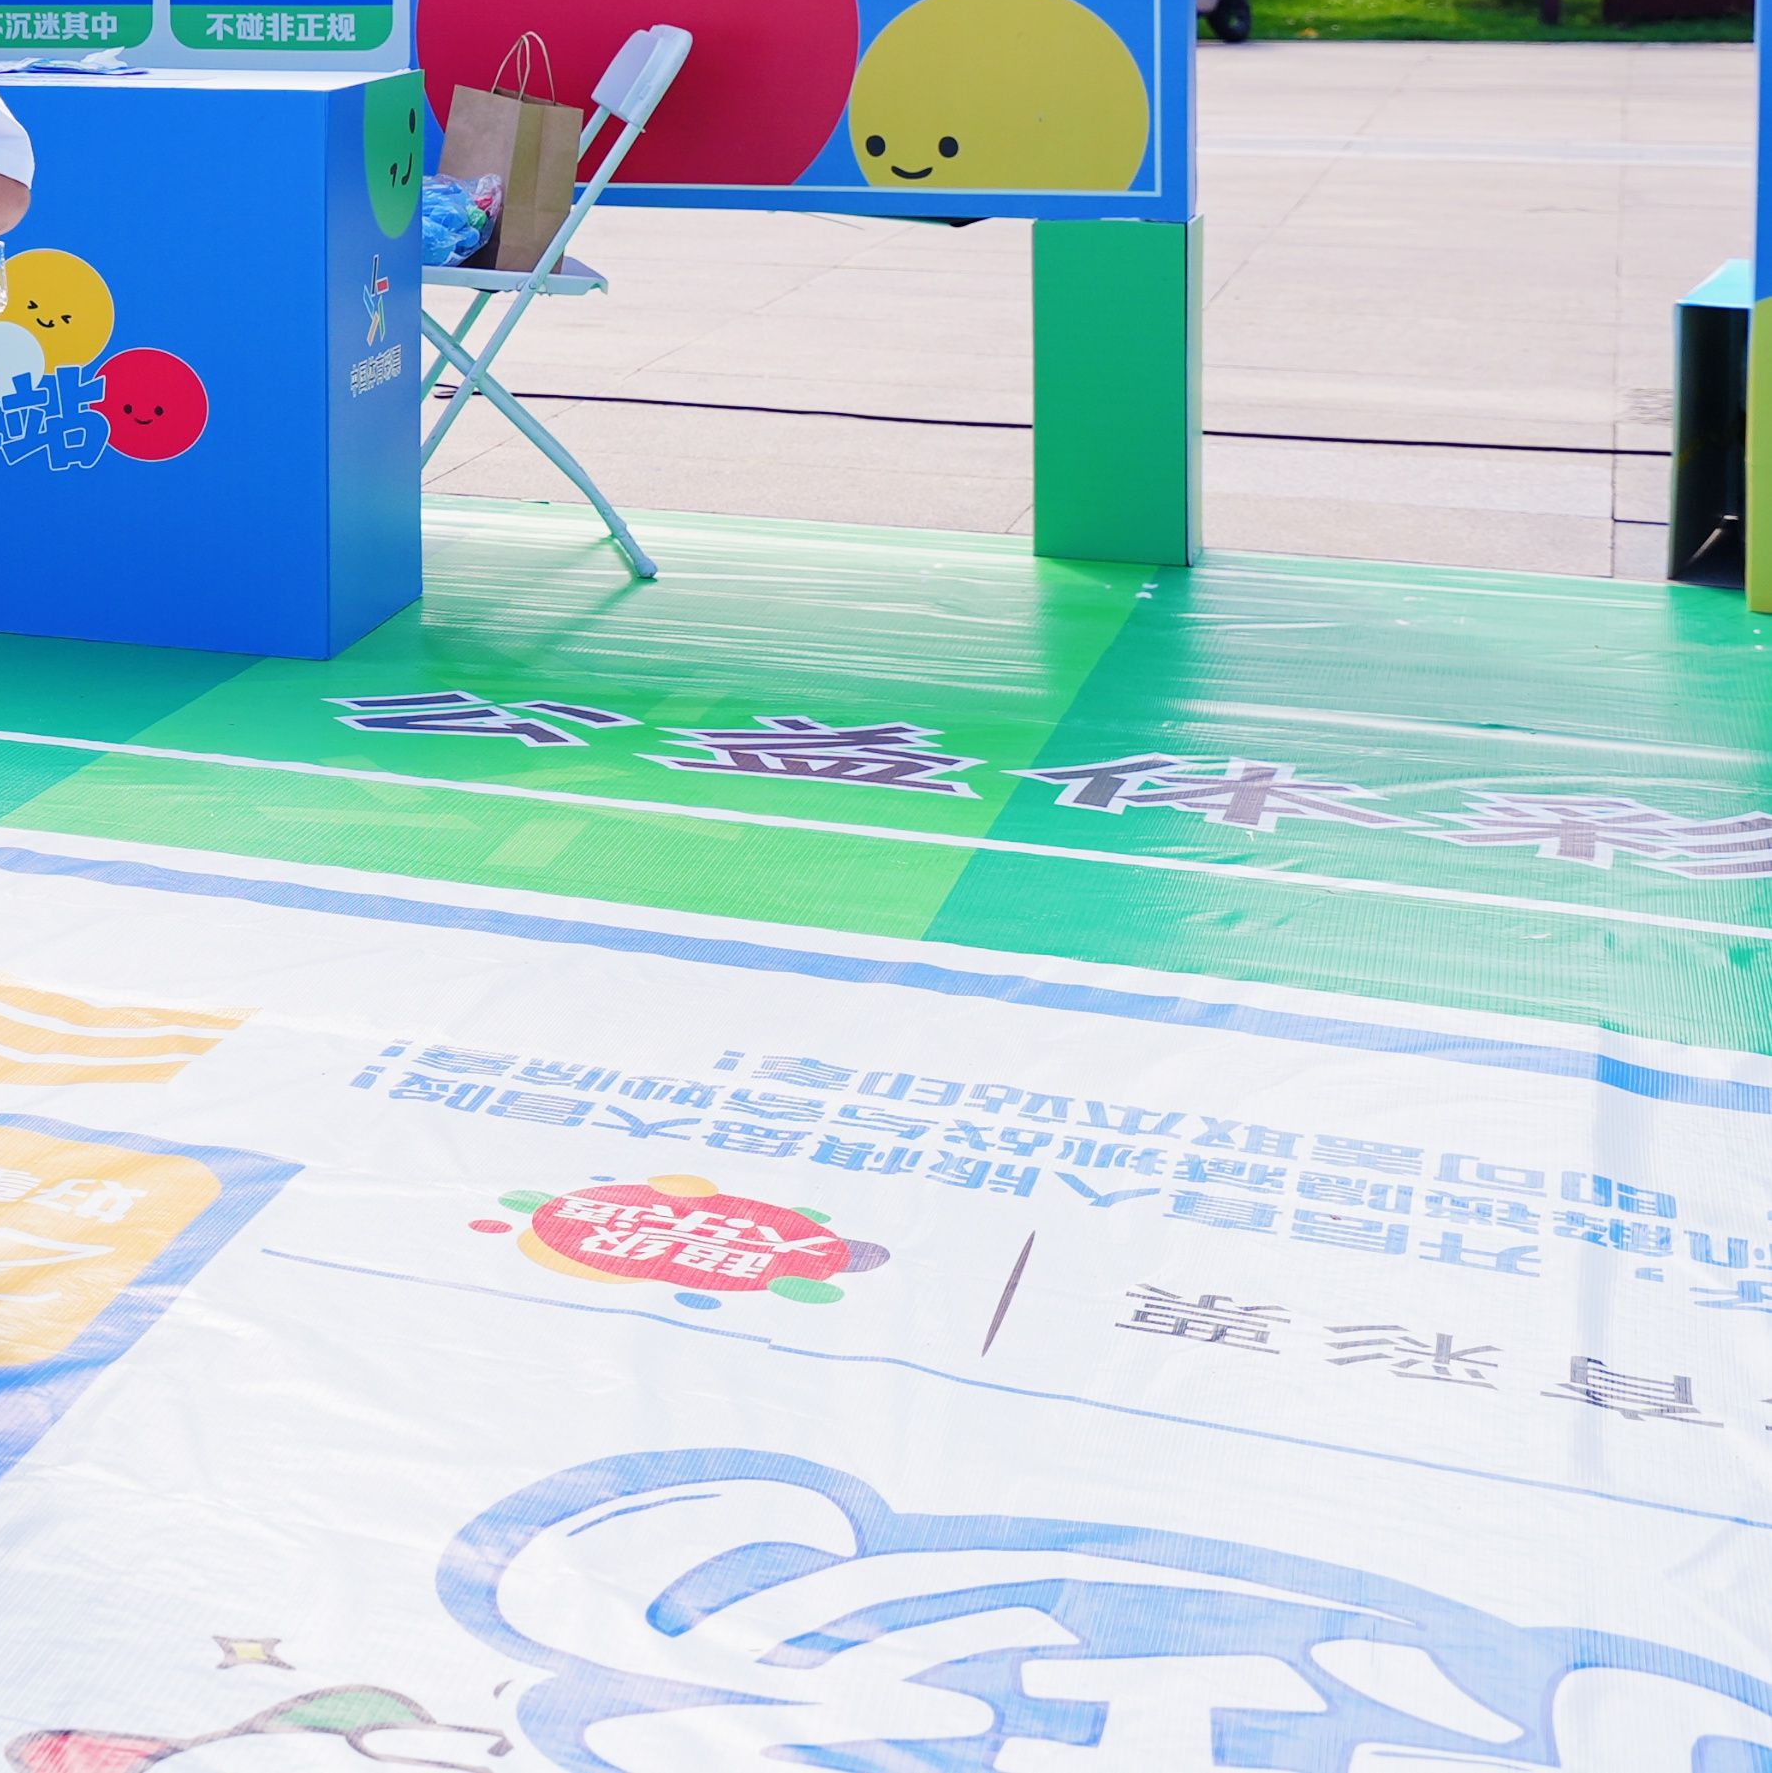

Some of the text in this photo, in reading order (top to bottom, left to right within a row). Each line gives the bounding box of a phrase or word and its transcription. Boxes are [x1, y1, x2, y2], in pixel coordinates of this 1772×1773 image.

[205, 13, 356, 43] 不碰非正规
[1115, 1283, 1772, 1430] 育彩票
